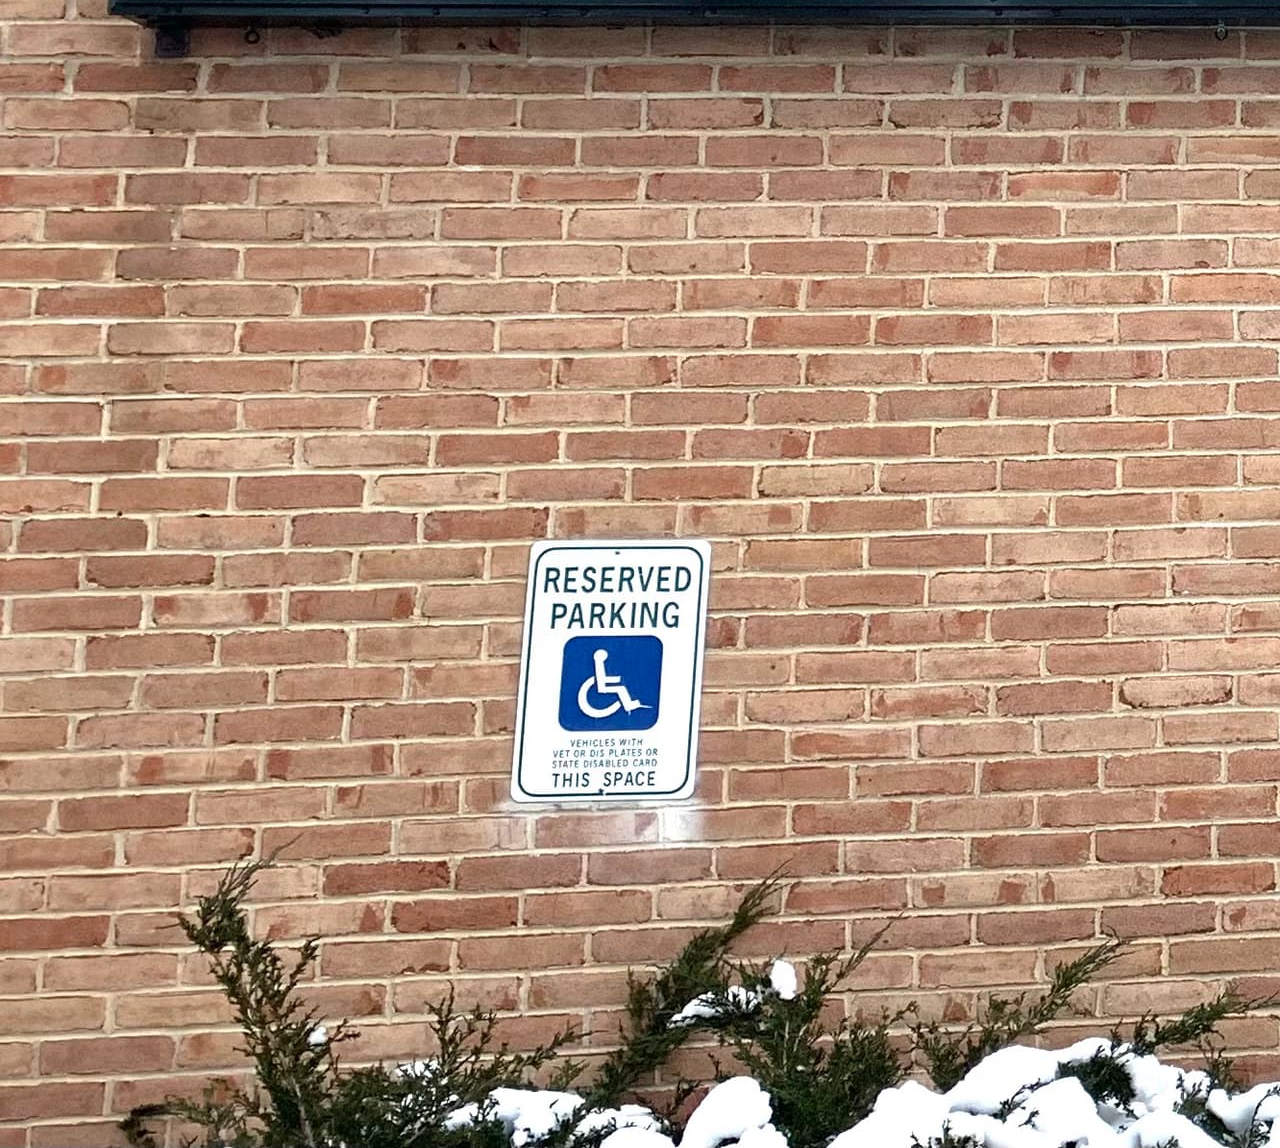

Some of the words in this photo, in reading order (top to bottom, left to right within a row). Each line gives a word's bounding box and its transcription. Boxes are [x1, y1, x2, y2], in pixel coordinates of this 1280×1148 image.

[544, 566, 691, 593] RESERVED
[551, 602, 680, 629] PARKING
[570, 739, 615, 747] VEHICLES
[620, 738, 643, 746] WITH
[553, 749, 570, 758] VET
[574, 749, 586, 757] OR
[590, 749, 605, 757] DIS
[608, 748, 642, 757] PLATES
[646, 748, 658, 756] OR
[552, 760, 580, 768] STATE
[584, 759, 628, 768] DISABLED
[633, 759, 657, 767] CARD
[552, 773, 590, 788] THIS
[603, 771, 656, 787] SPACE
